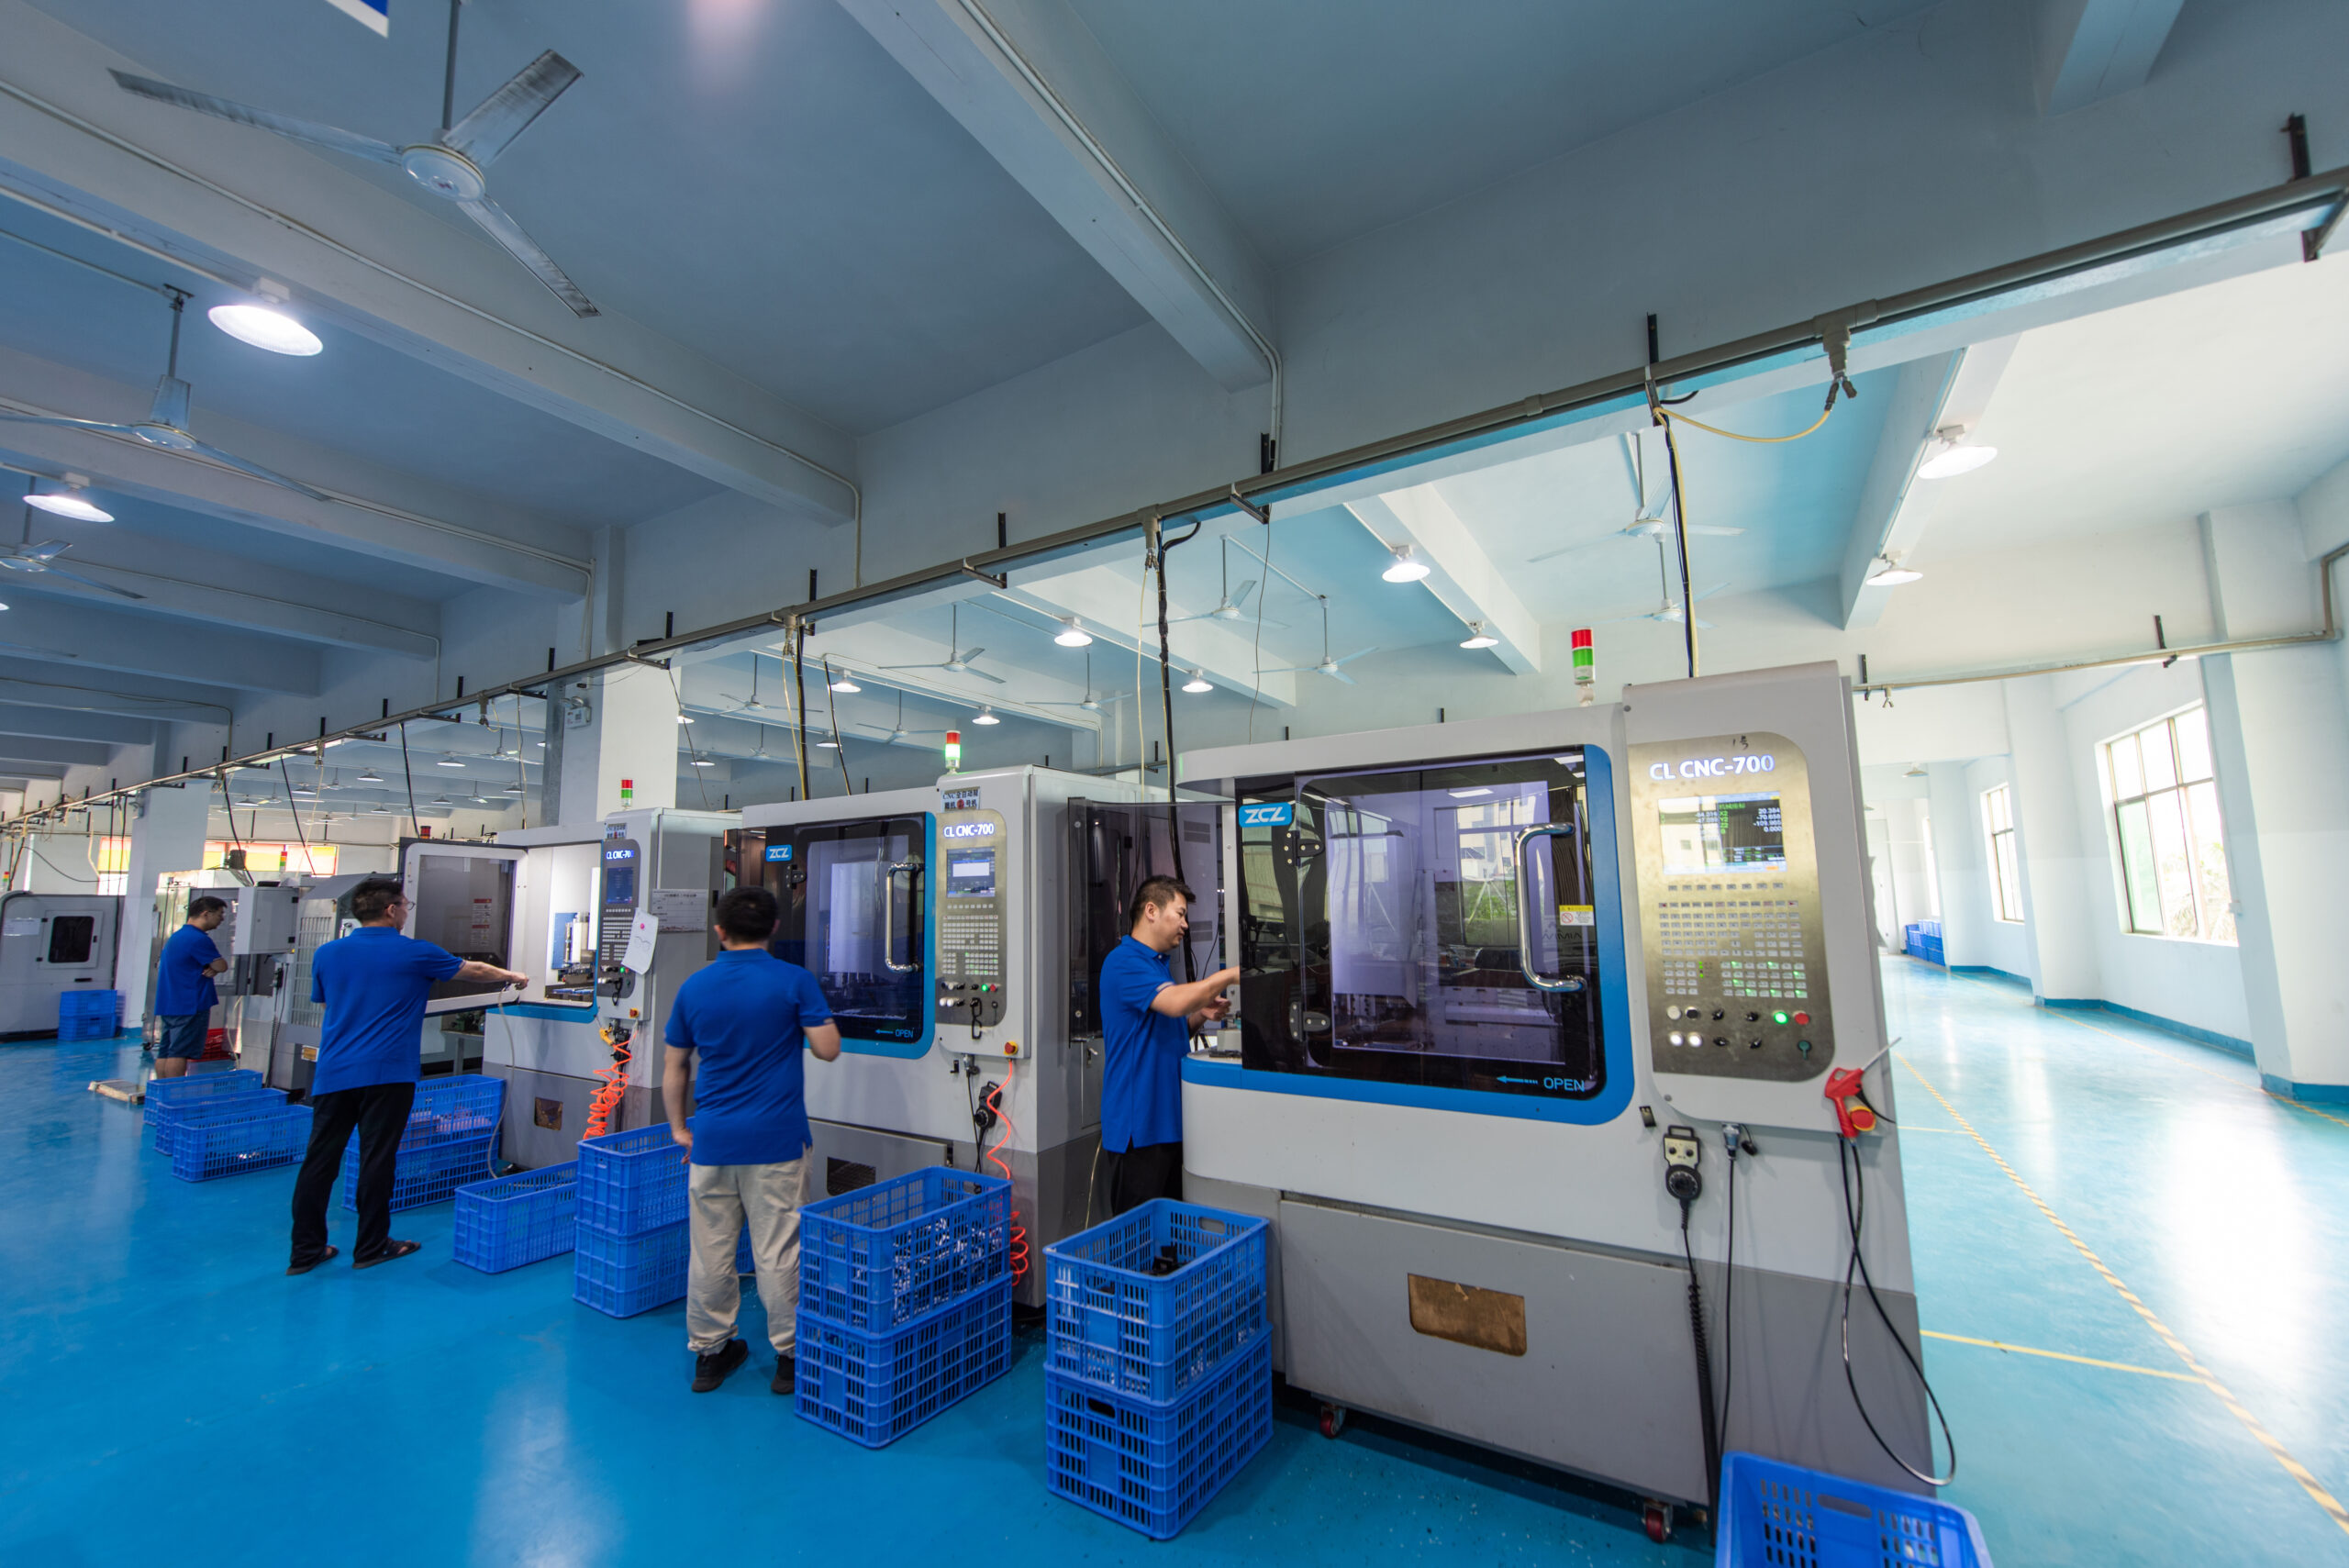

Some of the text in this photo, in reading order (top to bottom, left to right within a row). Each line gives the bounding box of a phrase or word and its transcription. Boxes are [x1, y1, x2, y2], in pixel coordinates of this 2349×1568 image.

[1650, 754, 1775, 780] CL CNC-700
[943, 823, 995, 838] CL CNC-700
[896, 1029, 914, 1038] OPEN
[1543, 1076, 1586, 1093] OPEN
